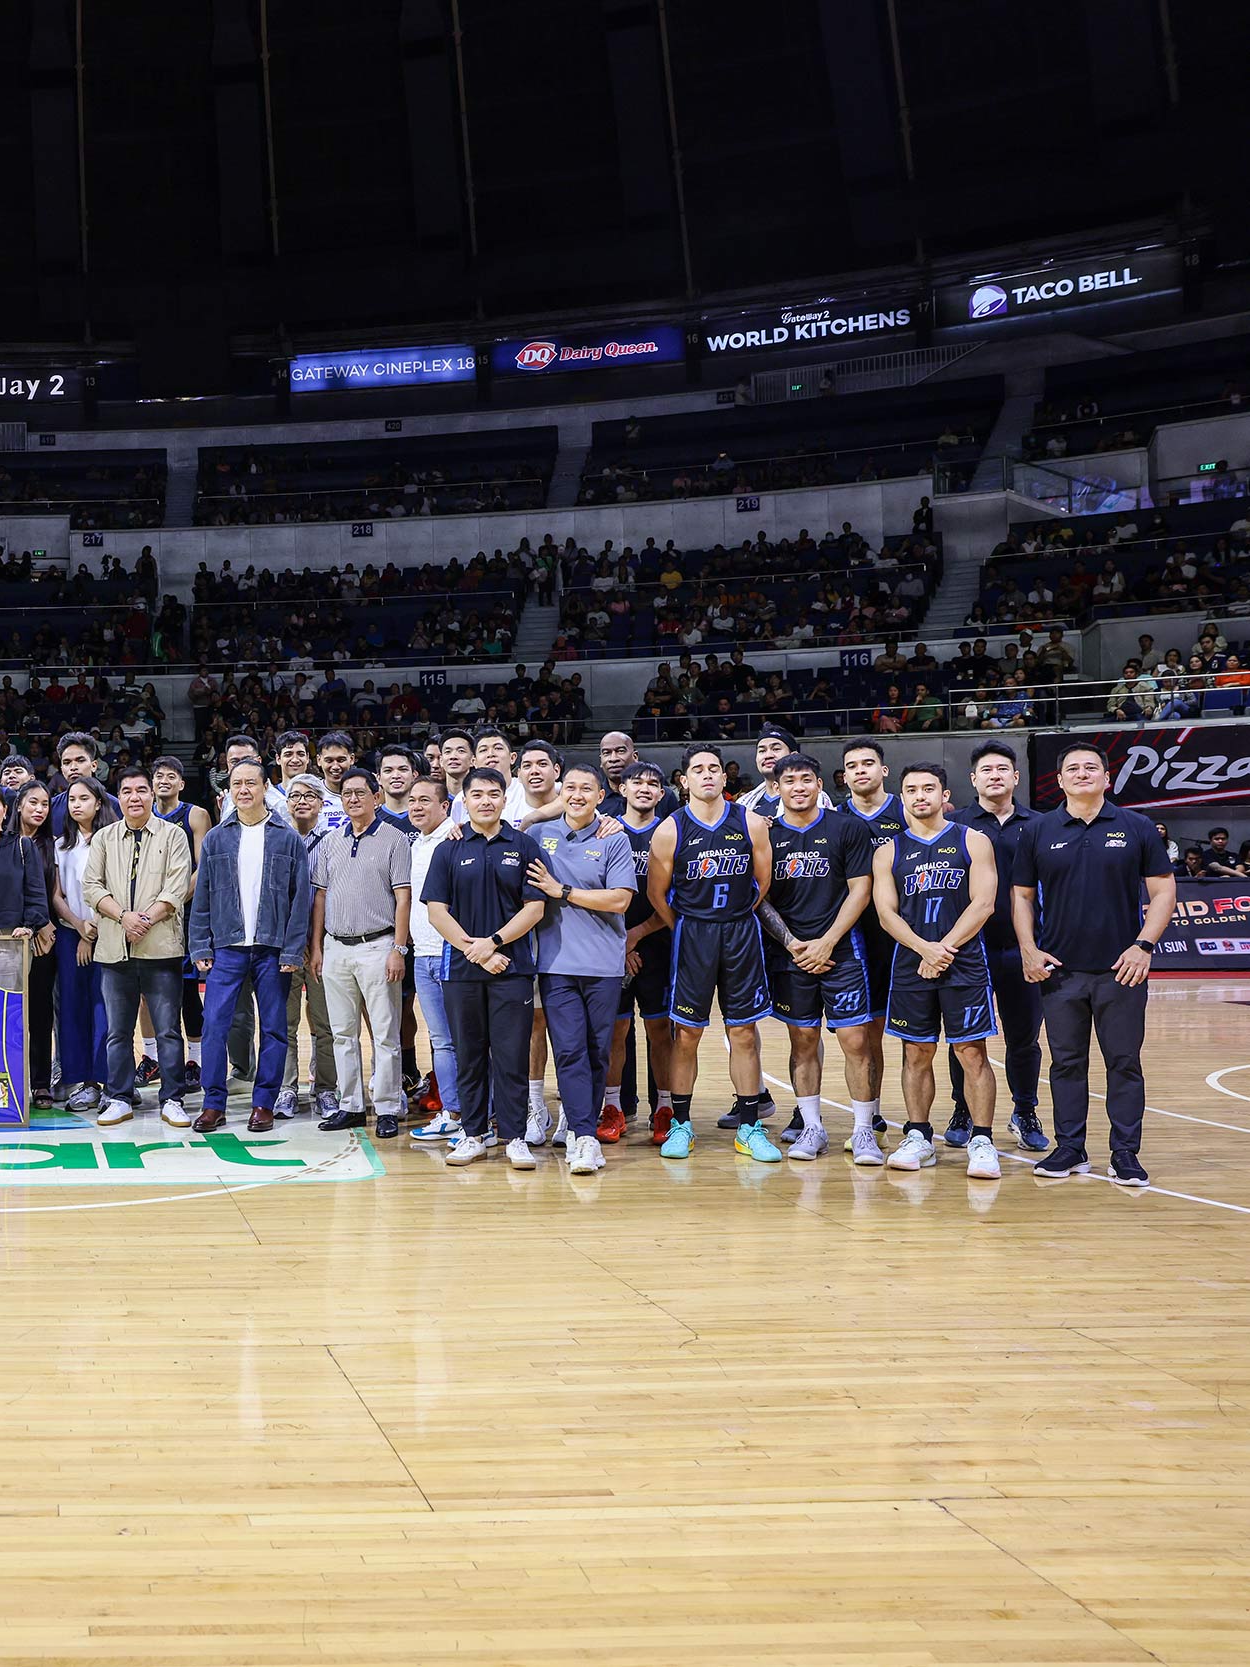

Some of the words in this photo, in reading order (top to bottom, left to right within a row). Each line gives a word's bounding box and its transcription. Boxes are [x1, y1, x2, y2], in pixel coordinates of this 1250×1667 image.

[1011, 278, 1074, 304] TACO
[707, 327, 789, 351] WORLD
[795, 309, 911, 340] KITCHENS
[523, 348, 550, 363] DQ
[559, 346, 602, 360] Dairy
[292, 364, 369, 381] GATEWAY
[374, 358, 452, 376] CINEPLEX
[457, 357, 475, 371] 18
[50, 375, 64, 395] 2
[738, 497, 759, 510] 219
[352, 523, 372, 535] 218
[83, 533, 102, 545] 217
[842, 653, 869, 666] 116
[421, 674, 445, 686] 115
[697, 848, 737, 860] MERALCO
[713, 883, 729, 909] 6
[924, 896, 944, 924] 17
[1172, 919, 1189, 927] TO
[1194, 915, 1247, 925] GOLDEN
[1164, 941, 1188, 954] SUN
[963, 1004, 986, 1029] 17
